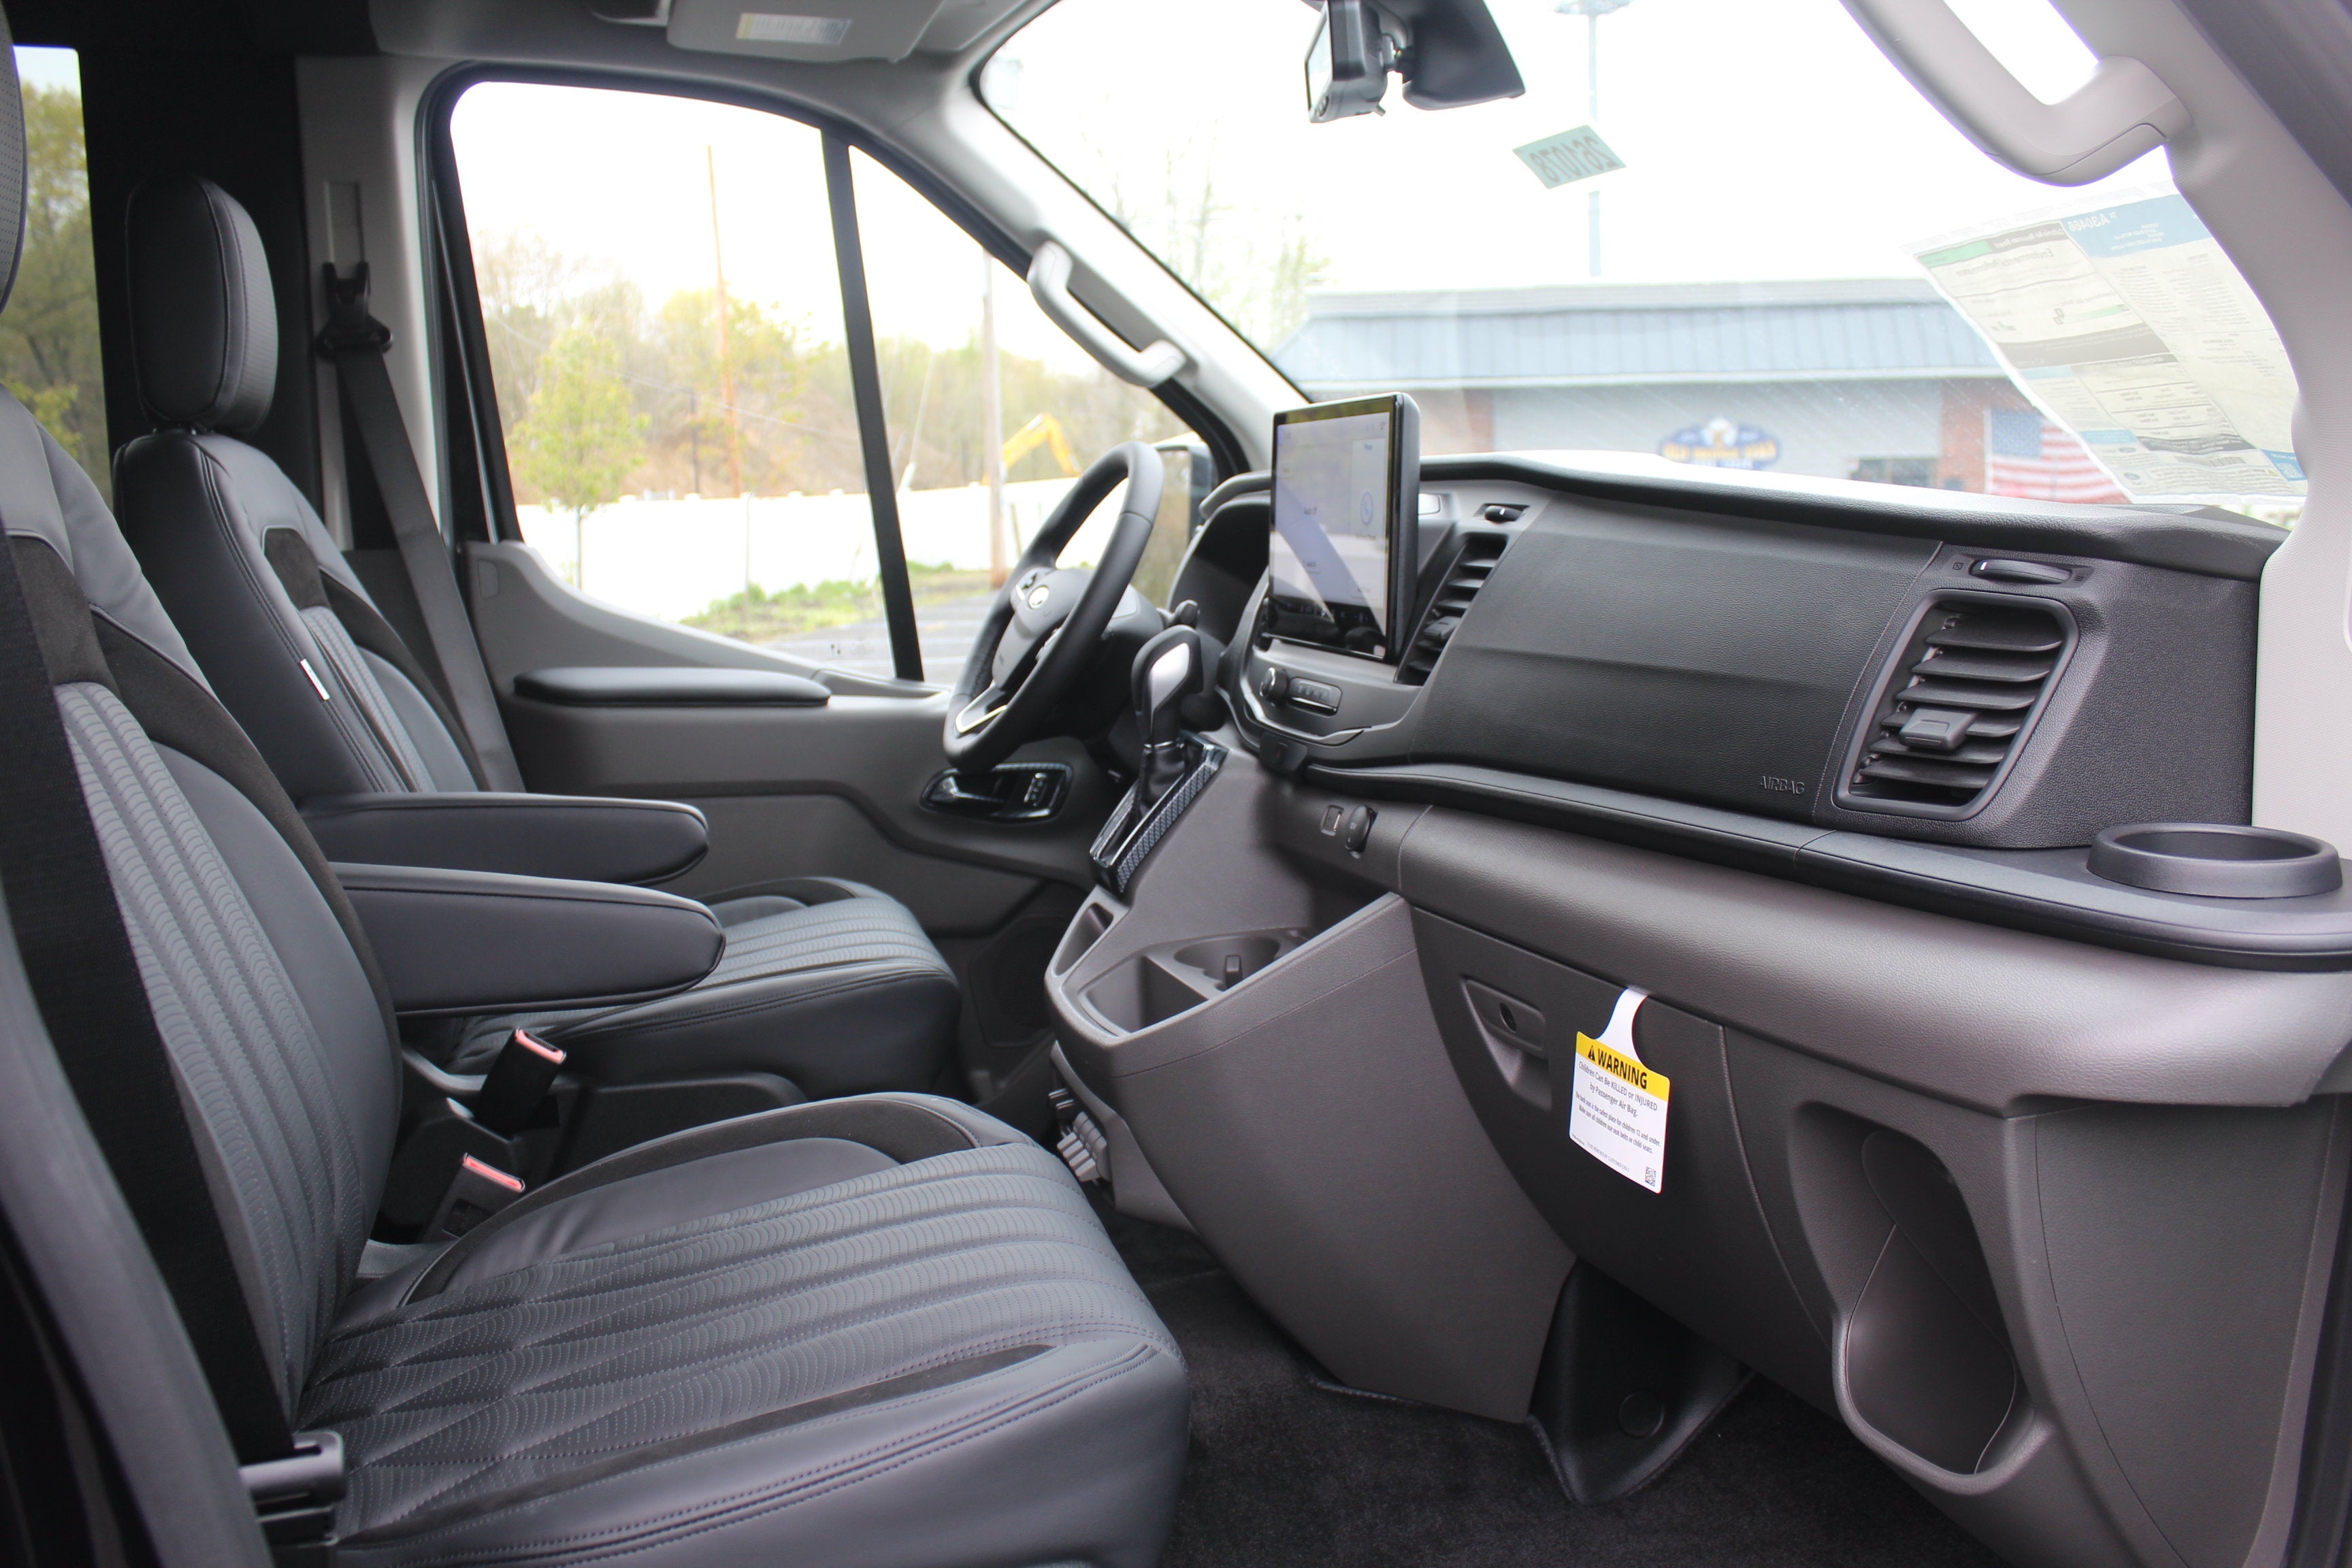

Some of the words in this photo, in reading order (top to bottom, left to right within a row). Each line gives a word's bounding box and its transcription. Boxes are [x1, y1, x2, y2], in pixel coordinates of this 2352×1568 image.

[1760, 775, 1805, 794] AIRBAG
[1579, 1061, 1595, 1075] Children
[1595, 1072, 1603, 1083] Can
[1604, 1078, 1611, 1088] Be
[1611, 1081, 1628, 1096] KILLED
[1635, 1094, 1658, 1111] INJURED
[1597, 1048, 1647, 1090] WARNING
[1590, 1082, 1595, 1093] by
[1595, 1085, 1618, 1105] Passenger
[1627, 1104, 1638, 1117] Bag.
[1622, 1122, 1635, 1134] children
[1636, 1129, 1641, 1137] 12
